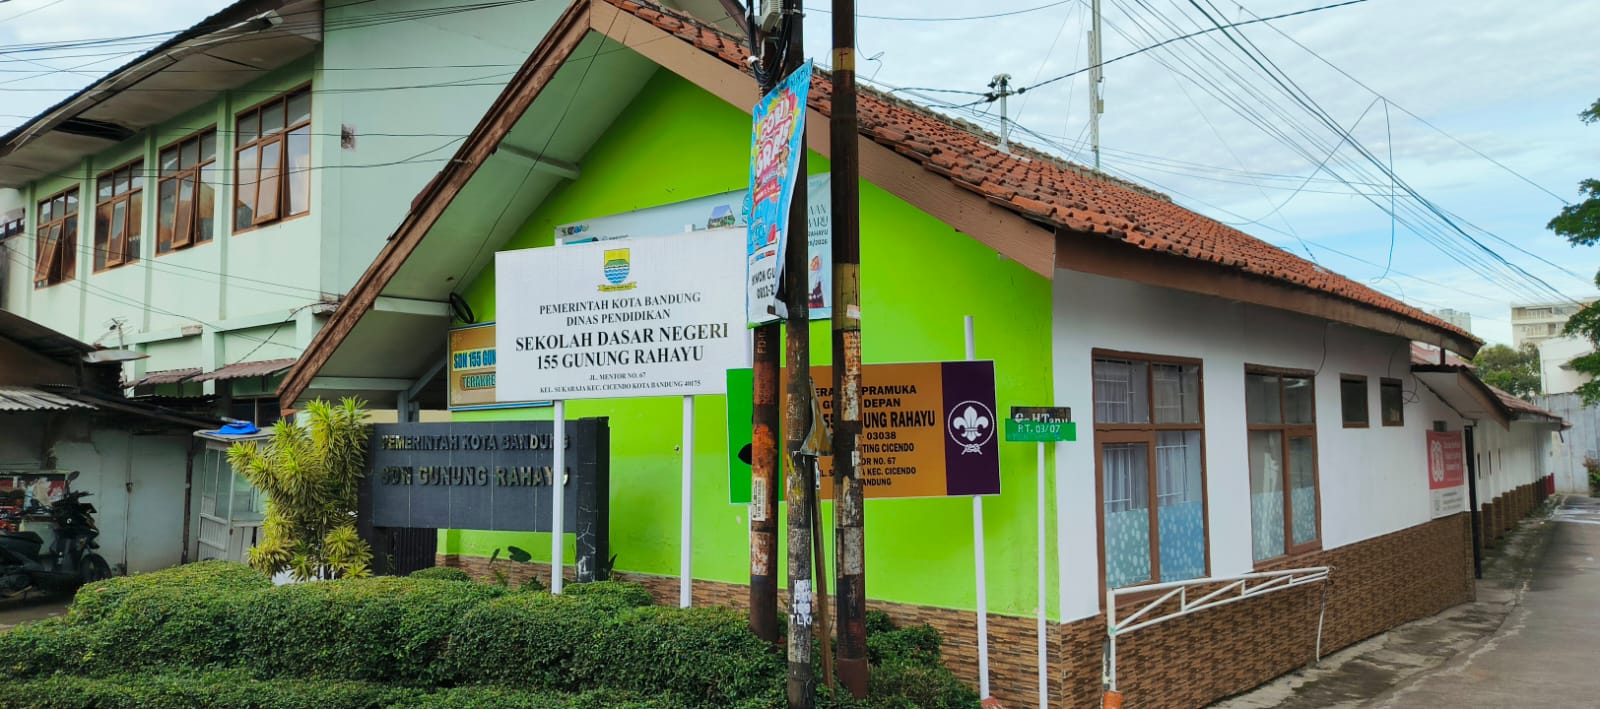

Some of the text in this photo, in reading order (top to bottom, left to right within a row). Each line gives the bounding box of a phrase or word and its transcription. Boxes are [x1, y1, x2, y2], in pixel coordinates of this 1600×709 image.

[539, 292, 701, 315] PEMERINTAH KOTA BANDUNG
[567, 309, 671, 327] DINAS PENDIDIKAN
[515, 322, 729, 352] SEKOLAH DASAR NEGERI
[453, 349, 496, 369] SDN 155 GUN
[538, 345, 704, 370] 155 GUNUNG RAHAYU
[463, 375, 496, 388] TERAKRE
[600, 373, 627, 381] MENTOR
[540, 385, 553, 393] KEL.
[602, 383, 631, 391] CICENDO
[651, 380, 683, 389] BANDUNG
[861, 385, 917, 396] PRAMUKA
[864, 398, 901, 409] DEPAN
[863, 410, 936, 429] UNG RAHAYU
[1035, 424, 1061, 433] 03/07
[381, 435, 460, 451] PEMERINTAH
[462, 434, 498, 450] KOTA
[867, 432, 897, 440] 03038
[863, 443, 915, 453] TING CICENDO
[873, 457, 886, 466] NO.
[887, 457, 897, 465] 67
[382, 467, 414, 487] SDN
[418, 466, 489, 487] GUNUNG
[867, 468, 884, 476] KEC.
[885, 467, 917, 475] CICENDO
[862, 478, 892, 487] ANDUNG
